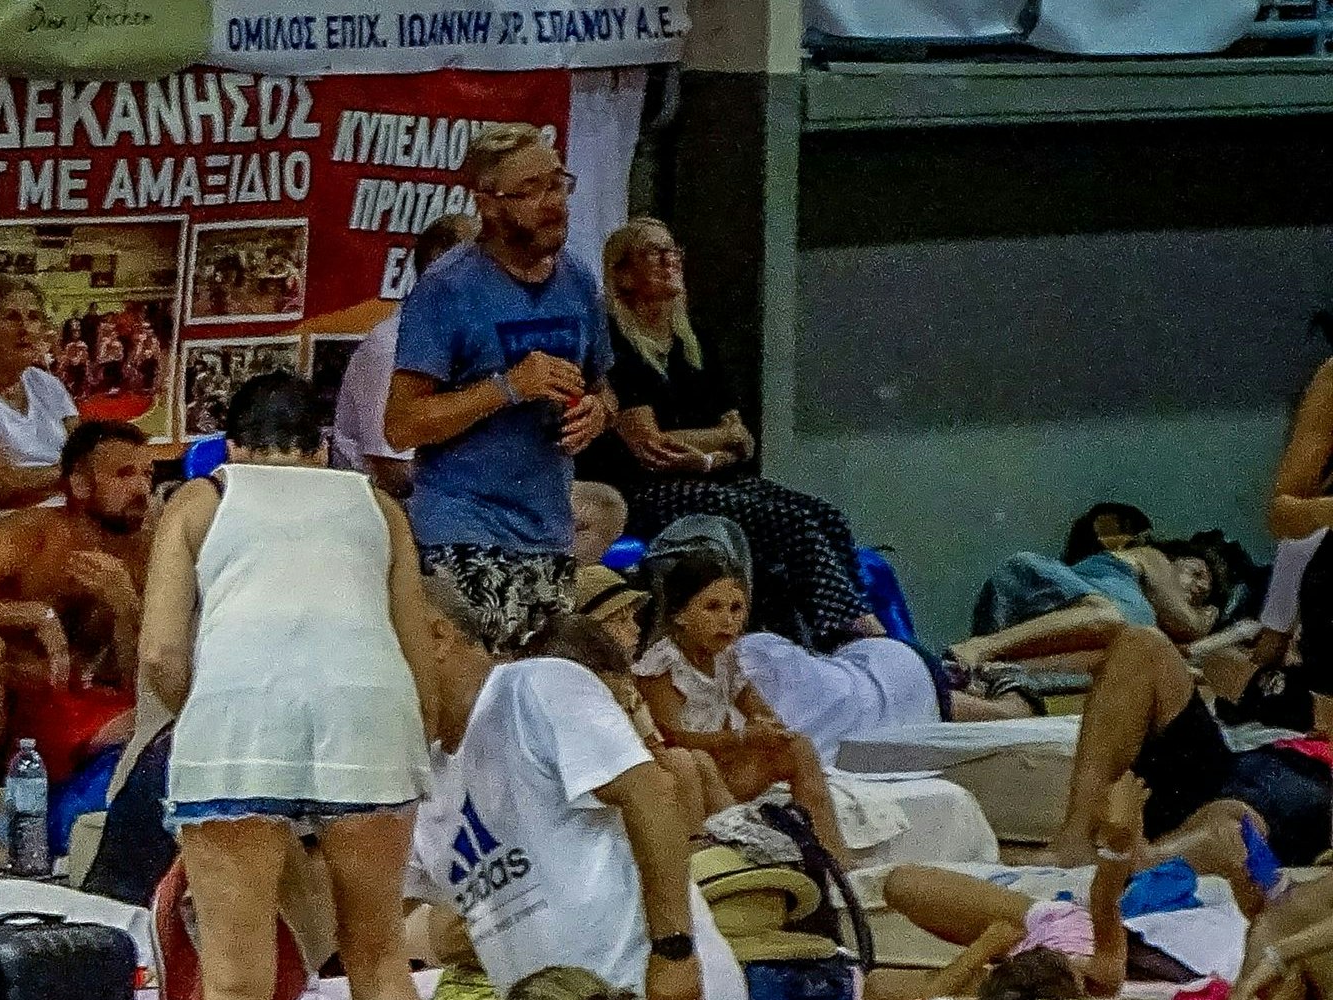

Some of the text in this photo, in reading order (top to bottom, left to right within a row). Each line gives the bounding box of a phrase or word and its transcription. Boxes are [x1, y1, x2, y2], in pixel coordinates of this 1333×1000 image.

[227, 16, 317, 51] ΟΜΙΛΟΣ
[326, 13, 388, 50] ΕΠΙΧ.
[397, 11, 492, 48] ΙΩΑΝΝΗ
[534, 9, 627, 44] ΣΠΑΝΟΥ
[636, 6, 683, 40] Α.Ε.
[18, 158, 92, 211] ΜΕ
[101, 150, 311, 210] ΑΜΑΞΙΔΙΟ
